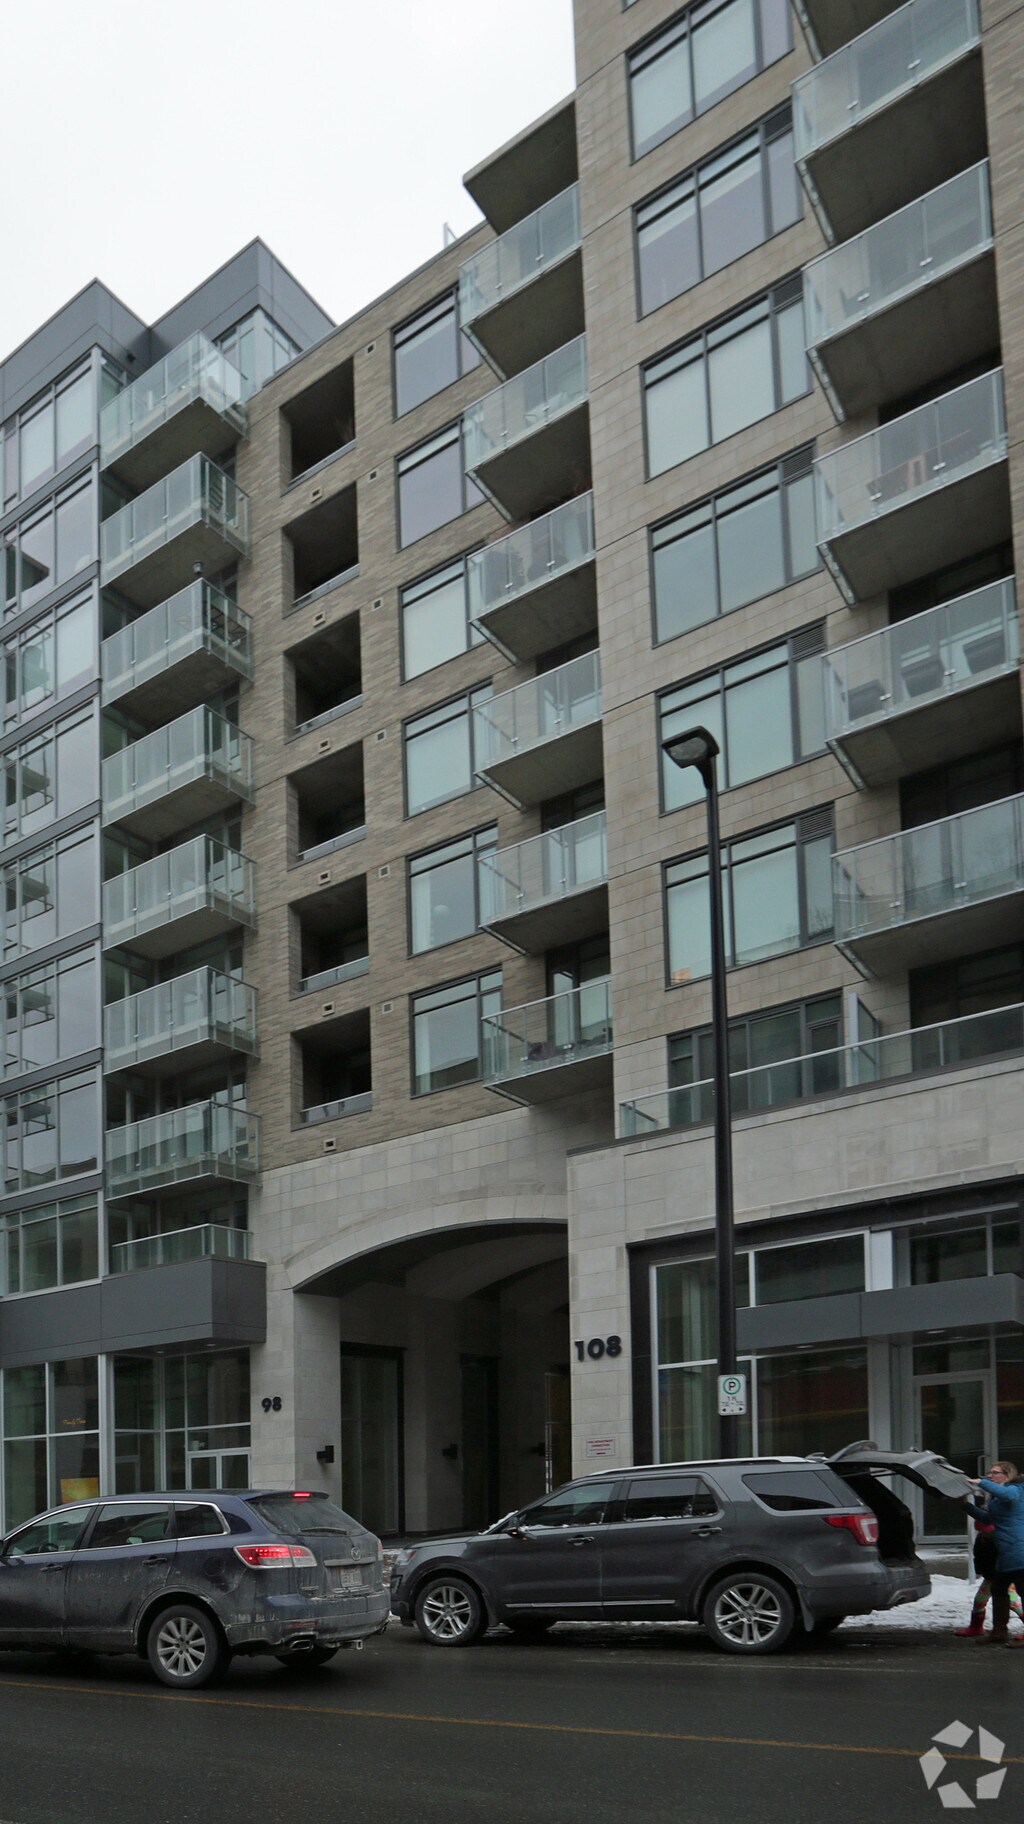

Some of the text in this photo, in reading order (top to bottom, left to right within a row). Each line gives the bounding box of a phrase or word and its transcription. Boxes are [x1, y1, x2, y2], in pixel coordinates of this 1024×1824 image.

[574, 1335, 622, 1362] 108
[728, 1381, 736, 1391] P
[261, 1396, 282, 1413] 98
